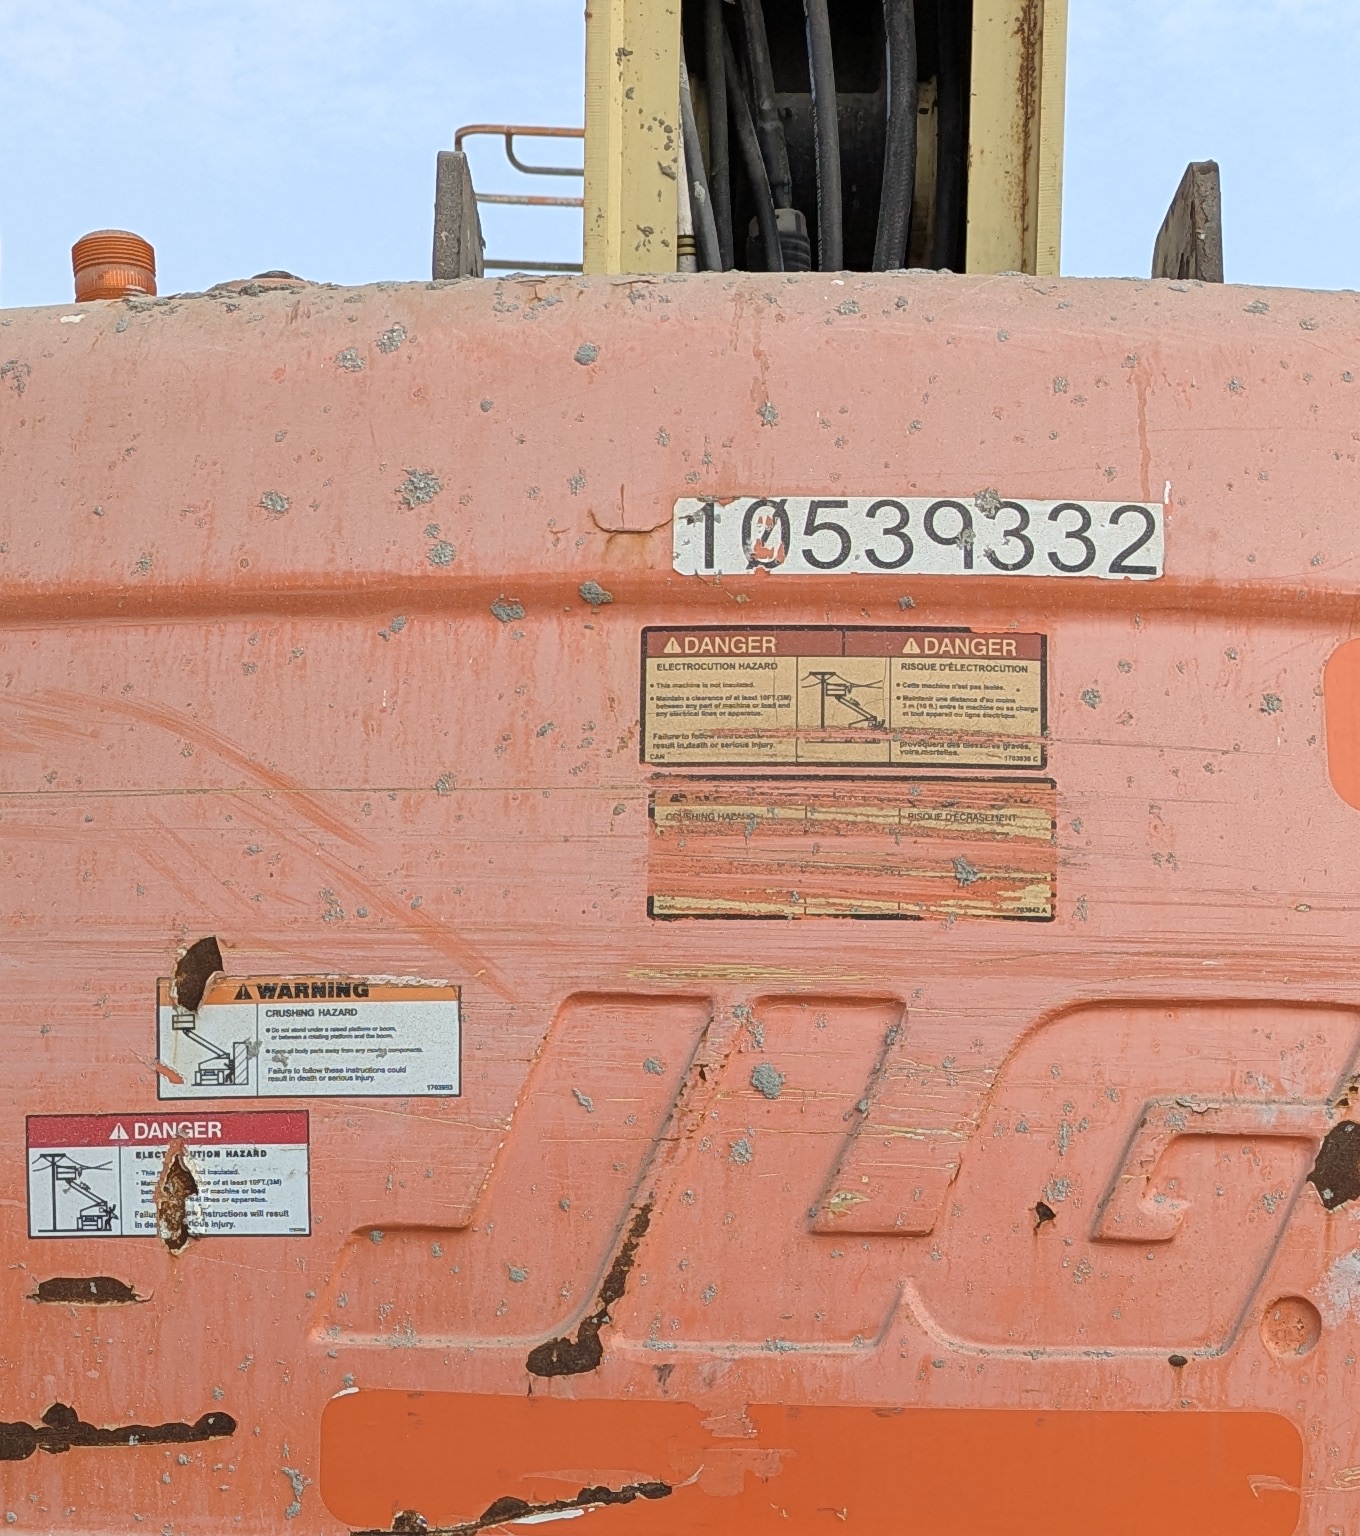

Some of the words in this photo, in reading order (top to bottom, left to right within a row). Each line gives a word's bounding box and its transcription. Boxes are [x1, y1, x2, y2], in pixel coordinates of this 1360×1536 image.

[697, 498, 1159, 575] 10539332
[684, 636, 776, 654] DANGER
[924, 637, 1017, 657] DANGER
[656, 662, 736, 671] ELECTROCUTION
[739, 662, 778, 670] HAZARD
[900, 662, 937, 672] RISQUE
[939, 662, 1028, 673] D'ÉLECTROCUTION
[257, 981, 369, 1000] WARNING
[266, 1009, 314, 1018] CRUSHING
[318, 1008, 358, 1017] HAZARD
[268, 1067, 292, 1075] Failure
[345, 1066, 386, 1074] instructions
[387, 1065, 407, 1074] could
[355, 1074, 375, 1082] injury.
[134, 1121, 222, 1139] DANGER
[135, 1150, 220, 1159] ELECTUTION
[225, 1150, 267, 1158] HAZARD
[250, 1210, 264, 1218] will
[265, 1210, 289, 1218] result
